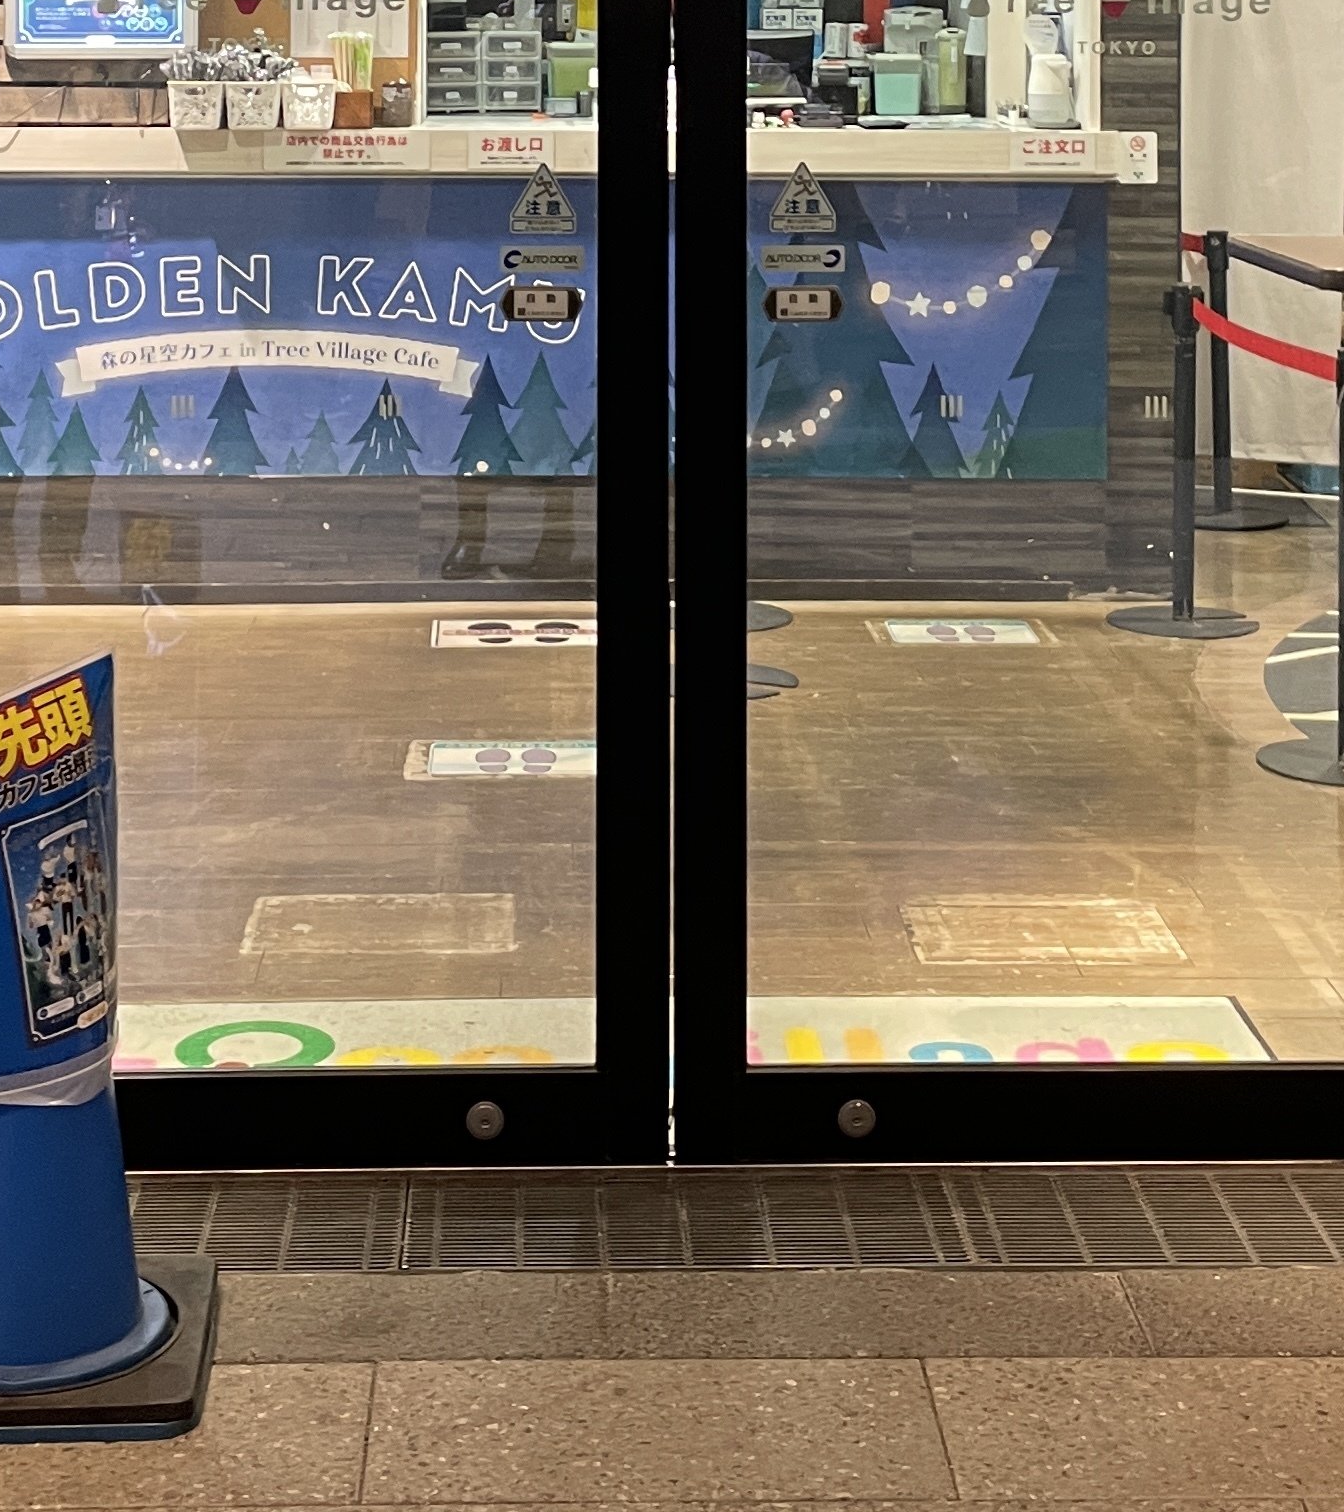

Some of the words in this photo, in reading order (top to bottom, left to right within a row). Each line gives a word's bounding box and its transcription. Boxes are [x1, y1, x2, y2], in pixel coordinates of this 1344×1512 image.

[1077, 40, 1156, 55] TOKYO
[481, 137, 543, 152] お渡し口
[1023, 139, 1086, 154] ご注文口
[525, 199, 561, 216] 注意
[100, 343, 233, 370] 森の星空カフェ
[240, 342, 256, 358] in
[261, 340, 310, 359] Tree
[316, 341, 388, 366] Village
[394, 347, 439, 370] Cafe
